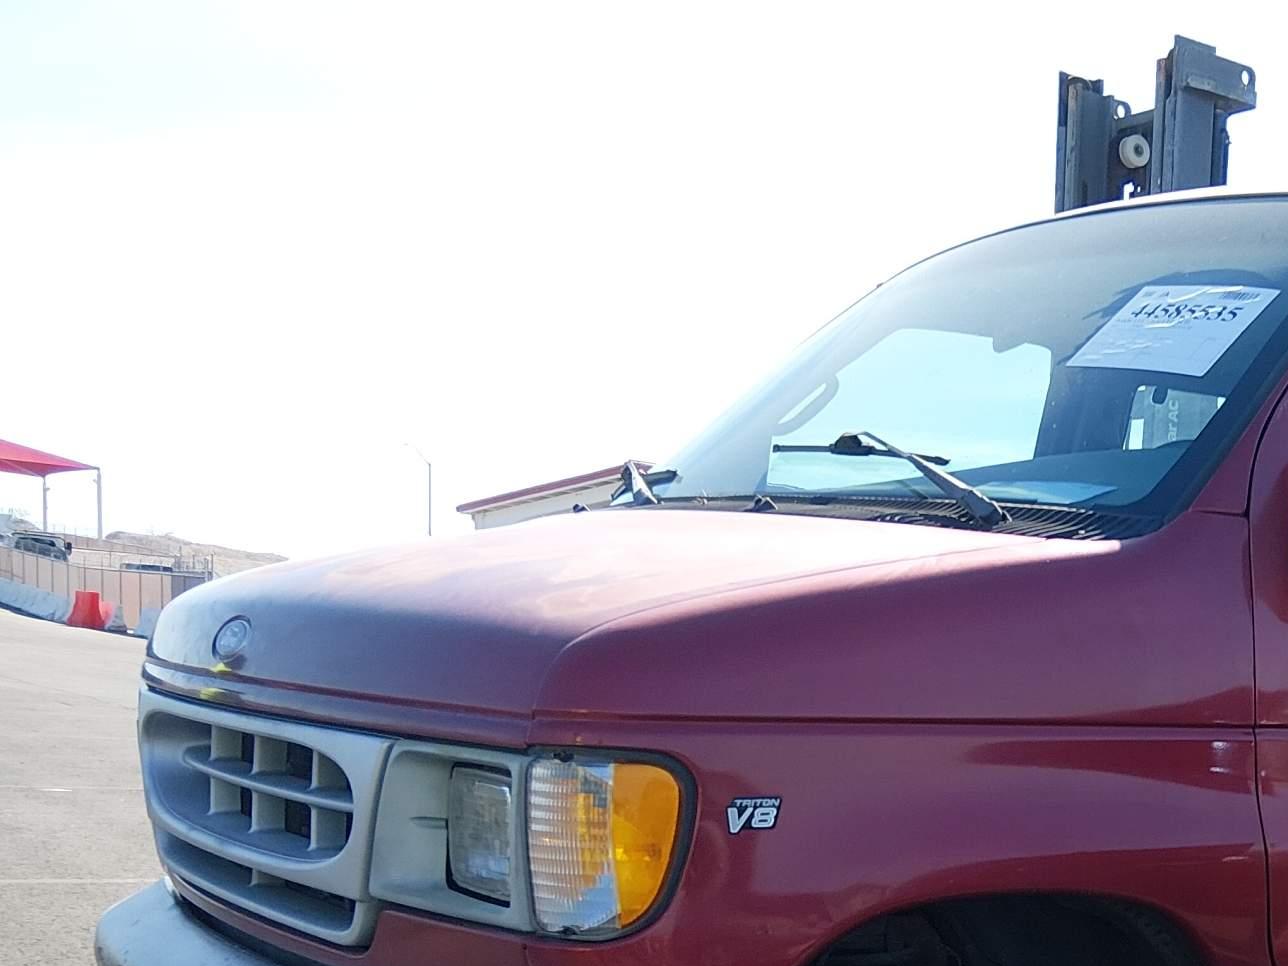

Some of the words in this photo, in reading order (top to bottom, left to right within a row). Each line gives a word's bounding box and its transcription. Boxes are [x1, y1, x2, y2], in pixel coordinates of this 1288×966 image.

[1131, 303, 1245, 322] 44585535
[733, 798, 780, 808] TRITON
[727, 807, 777, 834] V8
